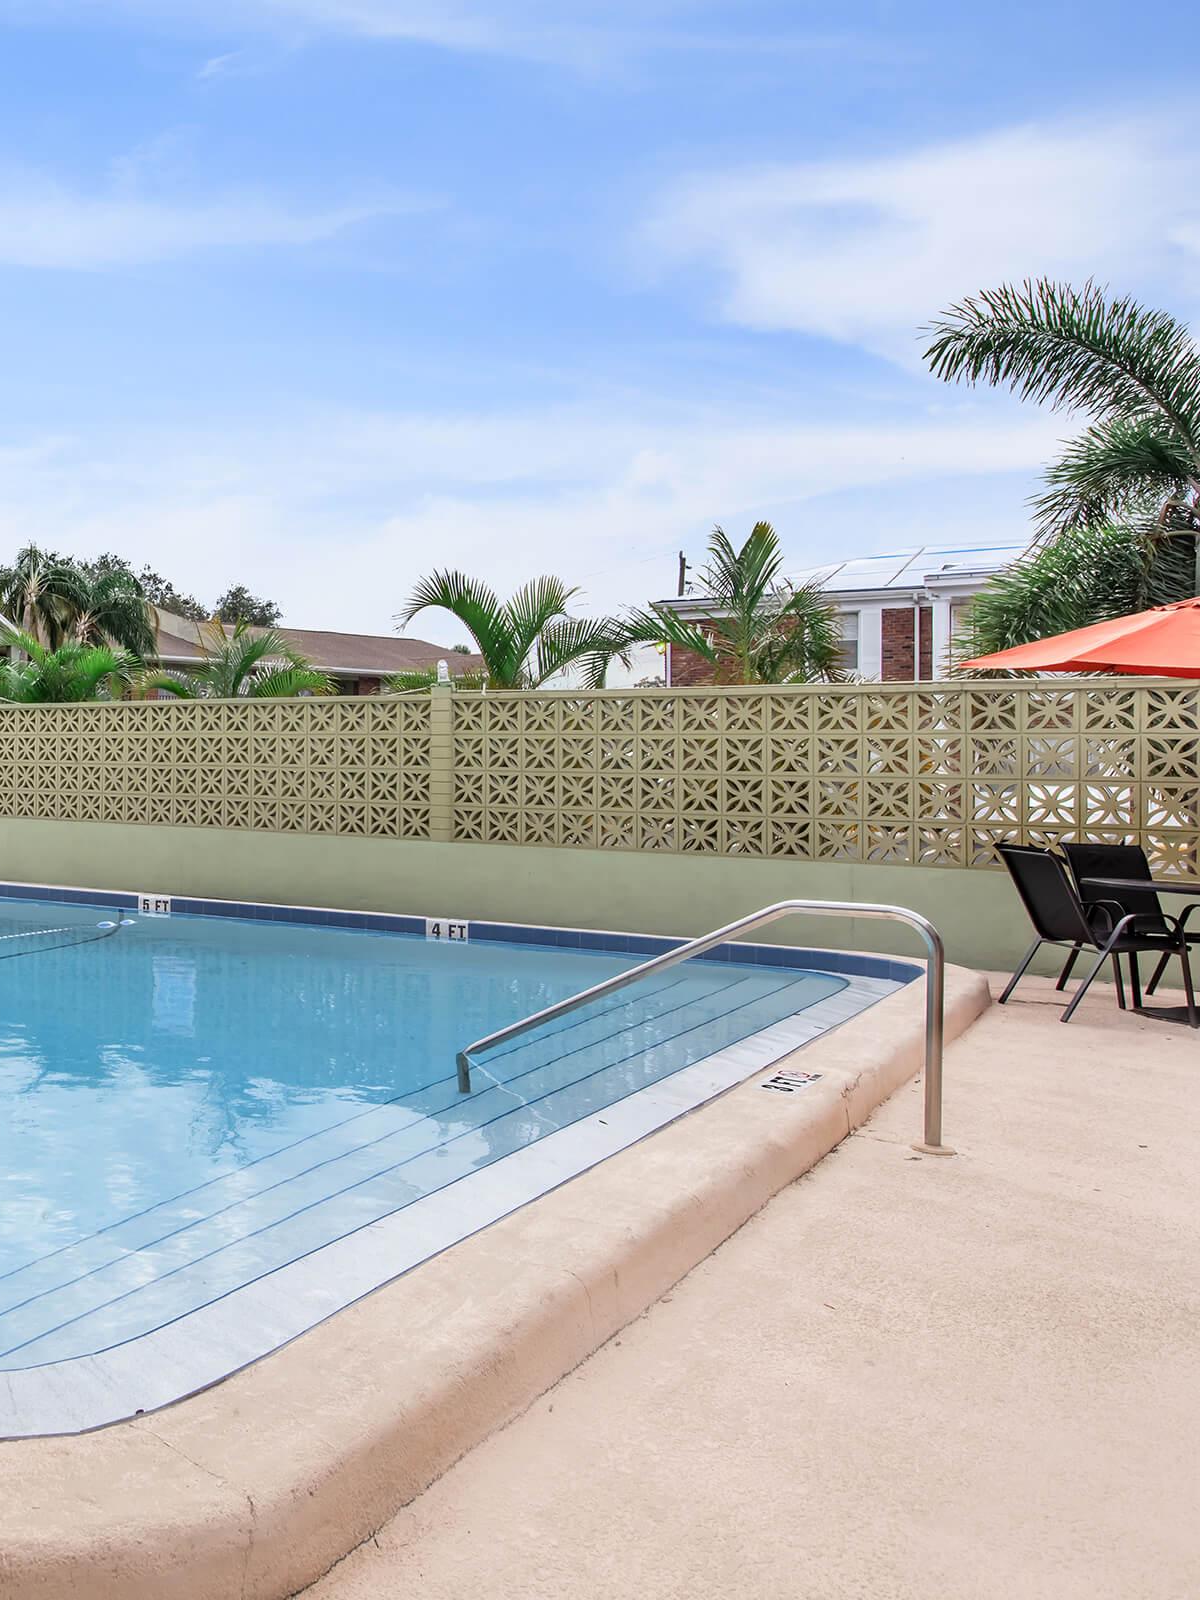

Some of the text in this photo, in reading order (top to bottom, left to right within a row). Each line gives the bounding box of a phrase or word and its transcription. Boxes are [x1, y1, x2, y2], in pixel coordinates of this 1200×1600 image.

[143, 899, 169, 912] 5 FT
[432, 923, 466, 938] 4 FT
[761, 1084, 794, 1092] 3
[770, 1076, 807, 1088] FT
